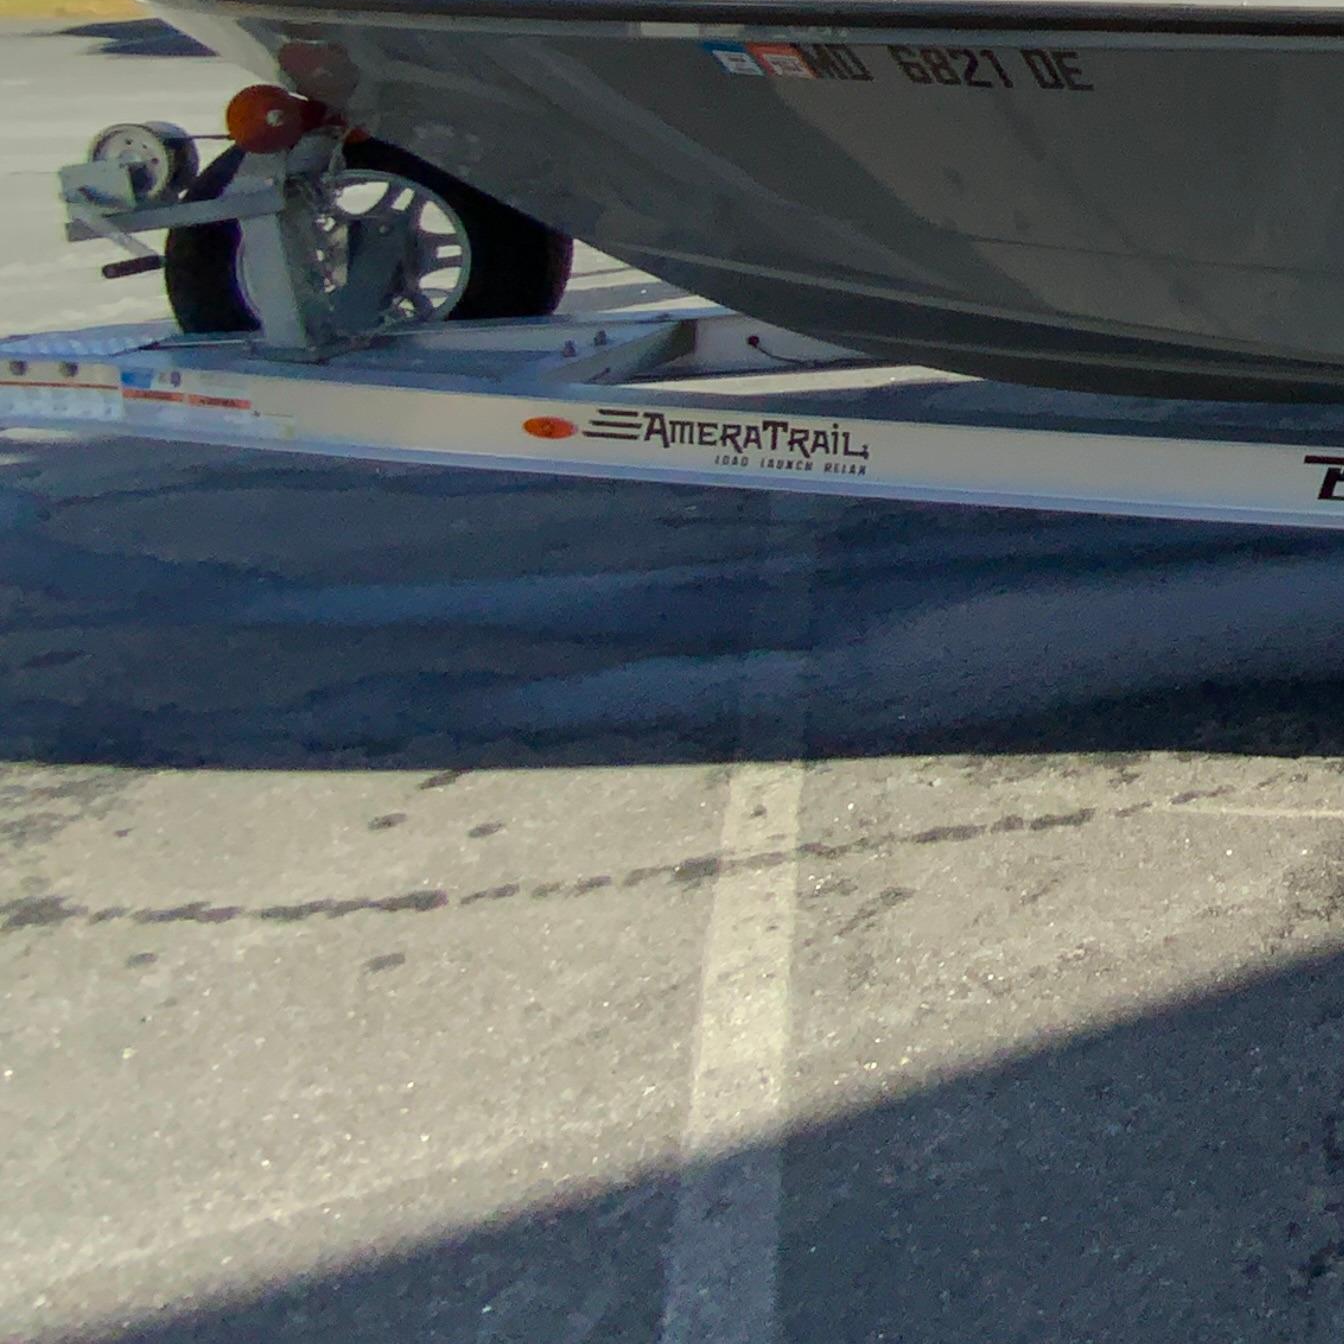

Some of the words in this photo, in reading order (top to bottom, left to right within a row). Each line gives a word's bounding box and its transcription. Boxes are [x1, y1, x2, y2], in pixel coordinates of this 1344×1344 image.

[886, 43, 1014, 89] 6821
[1020, 48, 1095, 91] DE
[714, 454, 749, 467] LOAD
[760, 457, 814, 472] LAUNCH
[823, 462, 867, 476] RELAX
